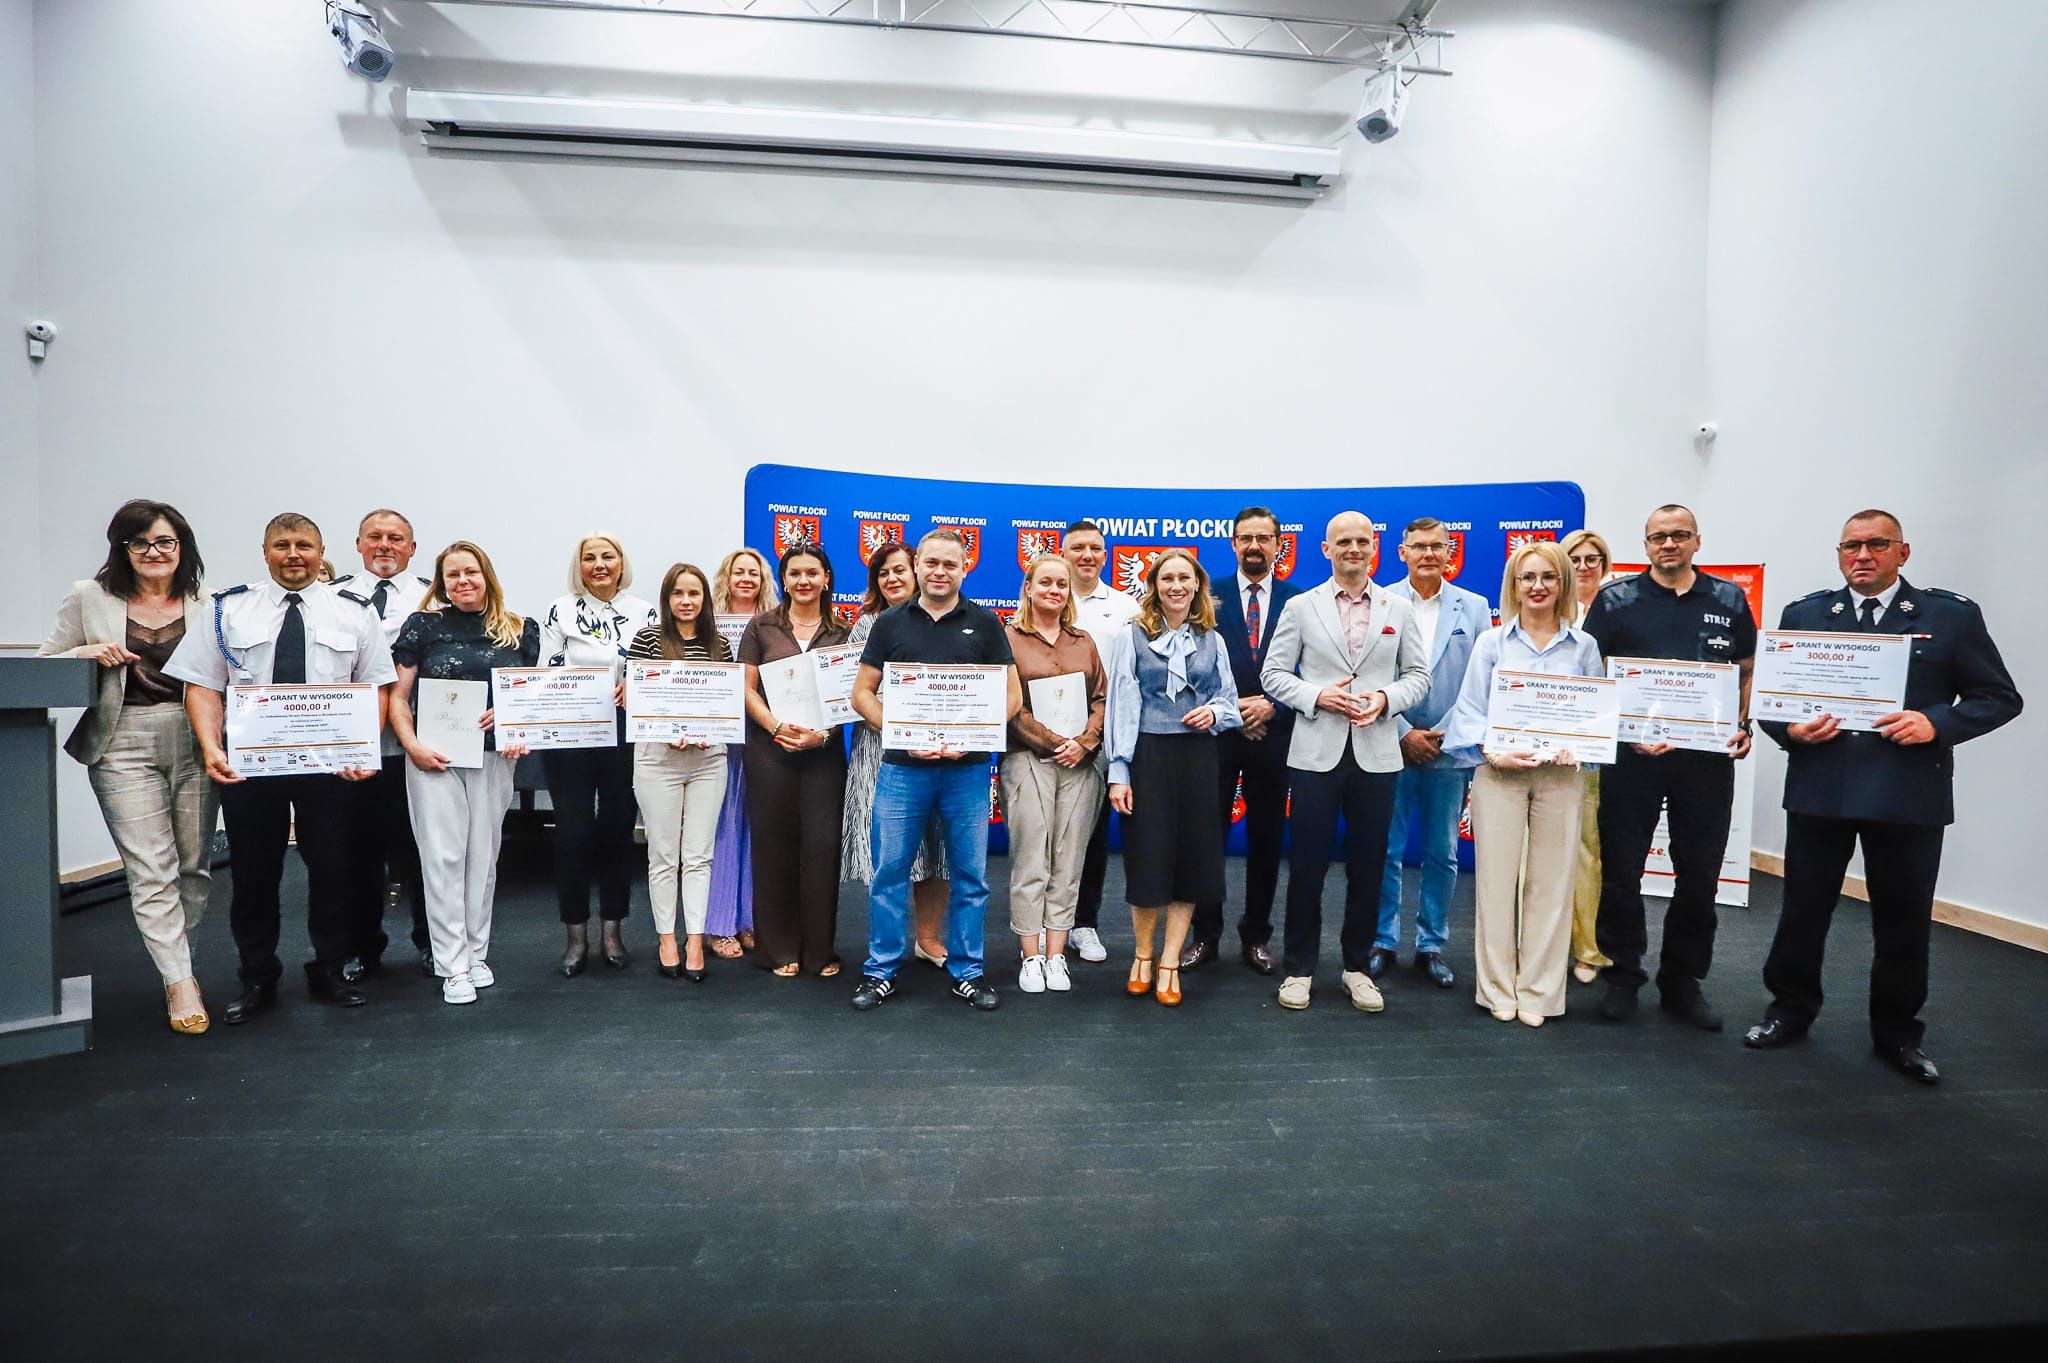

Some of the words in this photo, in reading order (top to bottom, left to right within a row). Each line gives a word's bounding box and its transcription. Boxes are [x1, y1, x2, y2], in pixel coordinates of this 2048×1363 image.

[769, 504, 798, 514] POWIAT
[799, 506, 827, 516] PŁOCKI
[853, 510, 882, 520] POWIAT
[883, 512, 910, 522] PŁOCKI
[931, 516, 959, 525] POWIAT
[960, 517, 987, 526] PŁOCKI
[1012, 520, 1040, 528] POWIAT
[1041, 520, 1067, 529] PŁOCKI
[1083, 517, 1158, 537] OWIAT
[1162, 518, 1235, 538] PŁOCKI
[1280, 524, 1303, 532] ŁOCKI
[1499, 520, 1531, 530] POWIAT
[1531, 519, 1563, 529] PŁOCKI
[997, 599, 1021, 608] PŁOCK
[1795, 641, 1822, 649] GRANT
[1832, 642, 1881, 652] WYSOKOŚCI
[1807, 652, 1844, 662] 3000,00
[1846, 654, 1854, 662] zł
[948, 672, 985, 680] WYSOKOŚCI
[1643, 668, 1666, 676] GRANT
[1676, 669, 1716, 679] WYSOKOŚCI
[927, 683, 958, 692] 4000,00
[1526, 681, 1549, 690] GRANT
[1558, 684, 1598, 694] WYSOKOŚCI
[1653, 678, 1685, 688] 3500,00
[1687, 680, 1695, 688] zł
[270, 693, 298, 702] GRANT
[298, 693, 309, 701] W
[309, 691, 353, 701] WYSOKOŚCI
[1535, 691, 1568, 701] 3000,00
[283, 702, 321, 712] 4000,00
[322, 702, 331, 711] zł
